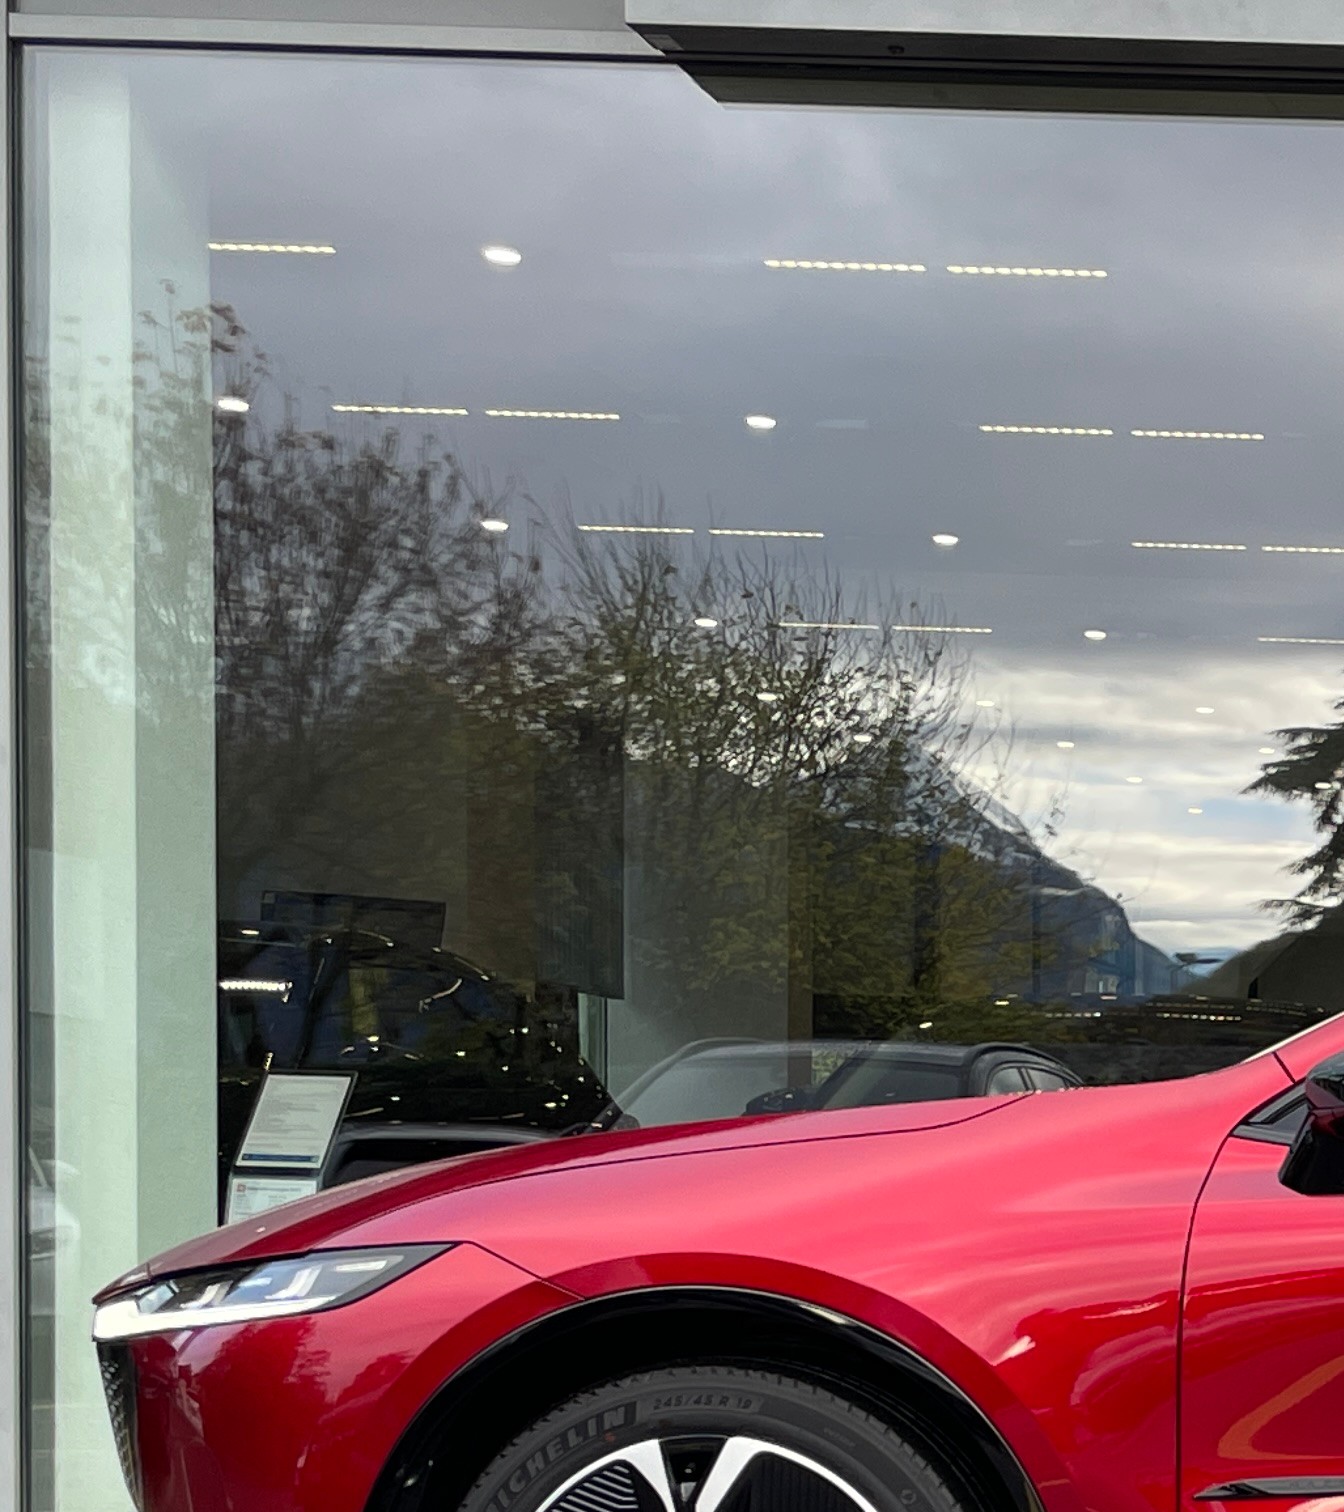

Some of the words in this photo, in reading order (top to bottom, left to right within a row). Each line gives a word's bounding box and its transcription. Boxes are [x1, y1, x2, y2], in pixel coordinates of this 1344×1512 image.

[654, 1394, 713, 1411] 245/45
[718, 1397, 730, 1408] R
[736, 1397, 753, 1410] 19
